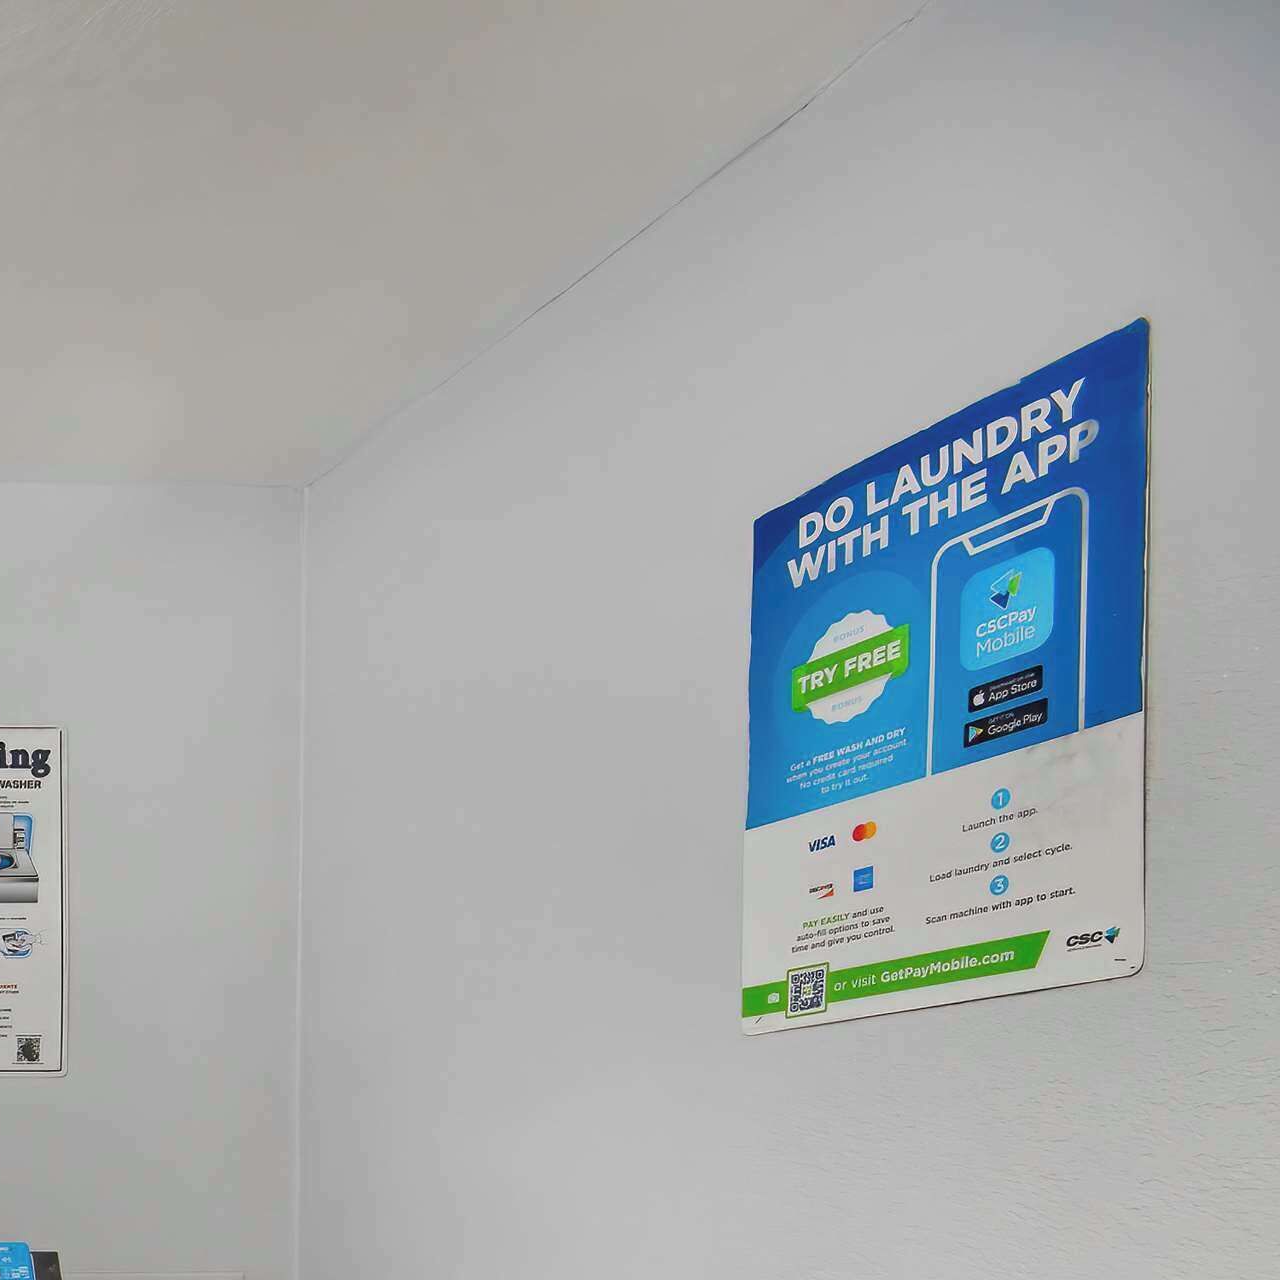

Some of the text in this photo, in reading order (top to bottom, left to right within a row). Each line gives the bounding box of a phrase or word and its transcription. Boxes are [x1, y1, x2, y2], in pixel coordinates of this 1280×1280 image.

[799, 377, 1086, 548] DO LAUNDRY
[787, 419, 1099, 588] WITH THE APP
[976, 606, 1036, 637] CSCPay
[976, 626, 1035, 657] Mobile
[798, 640, 901, 694] TRY FREE
[988, 689, 1008, 702] App
[1011, 679, 1037, 694] Store
[988, 712, 1042, 734] Google Play
[790, 762, 804, 771] Get
[813, 751, 834, 764] FREE
[837, 742, 863, 756] WASH
[865, 735, 884, 747] AND
[887, 727, 906, 739] DRY
[997, 792, 1003, 806] 1
[962, 807, 1038, 832] Launch the app.
[809, 835, 836, 852] VISA
[995, 835, 1005, 850] 2
[929, 842, 1072, 882] Load laundry and select cycle.
[994, 878, 1004, 892] 3
[803, 906, 884, 929] PAY EASILY and use
[926, 887, 1075, 925] Scan machine with app to start.
[791, 926, 895, 953] time and give you control.
[797, 916, 890, 941] auto-fill options to save
[1066, 931, 1103, 948] CSC
[833, 949, 1015, 992] or visit GetPayMobile.com
